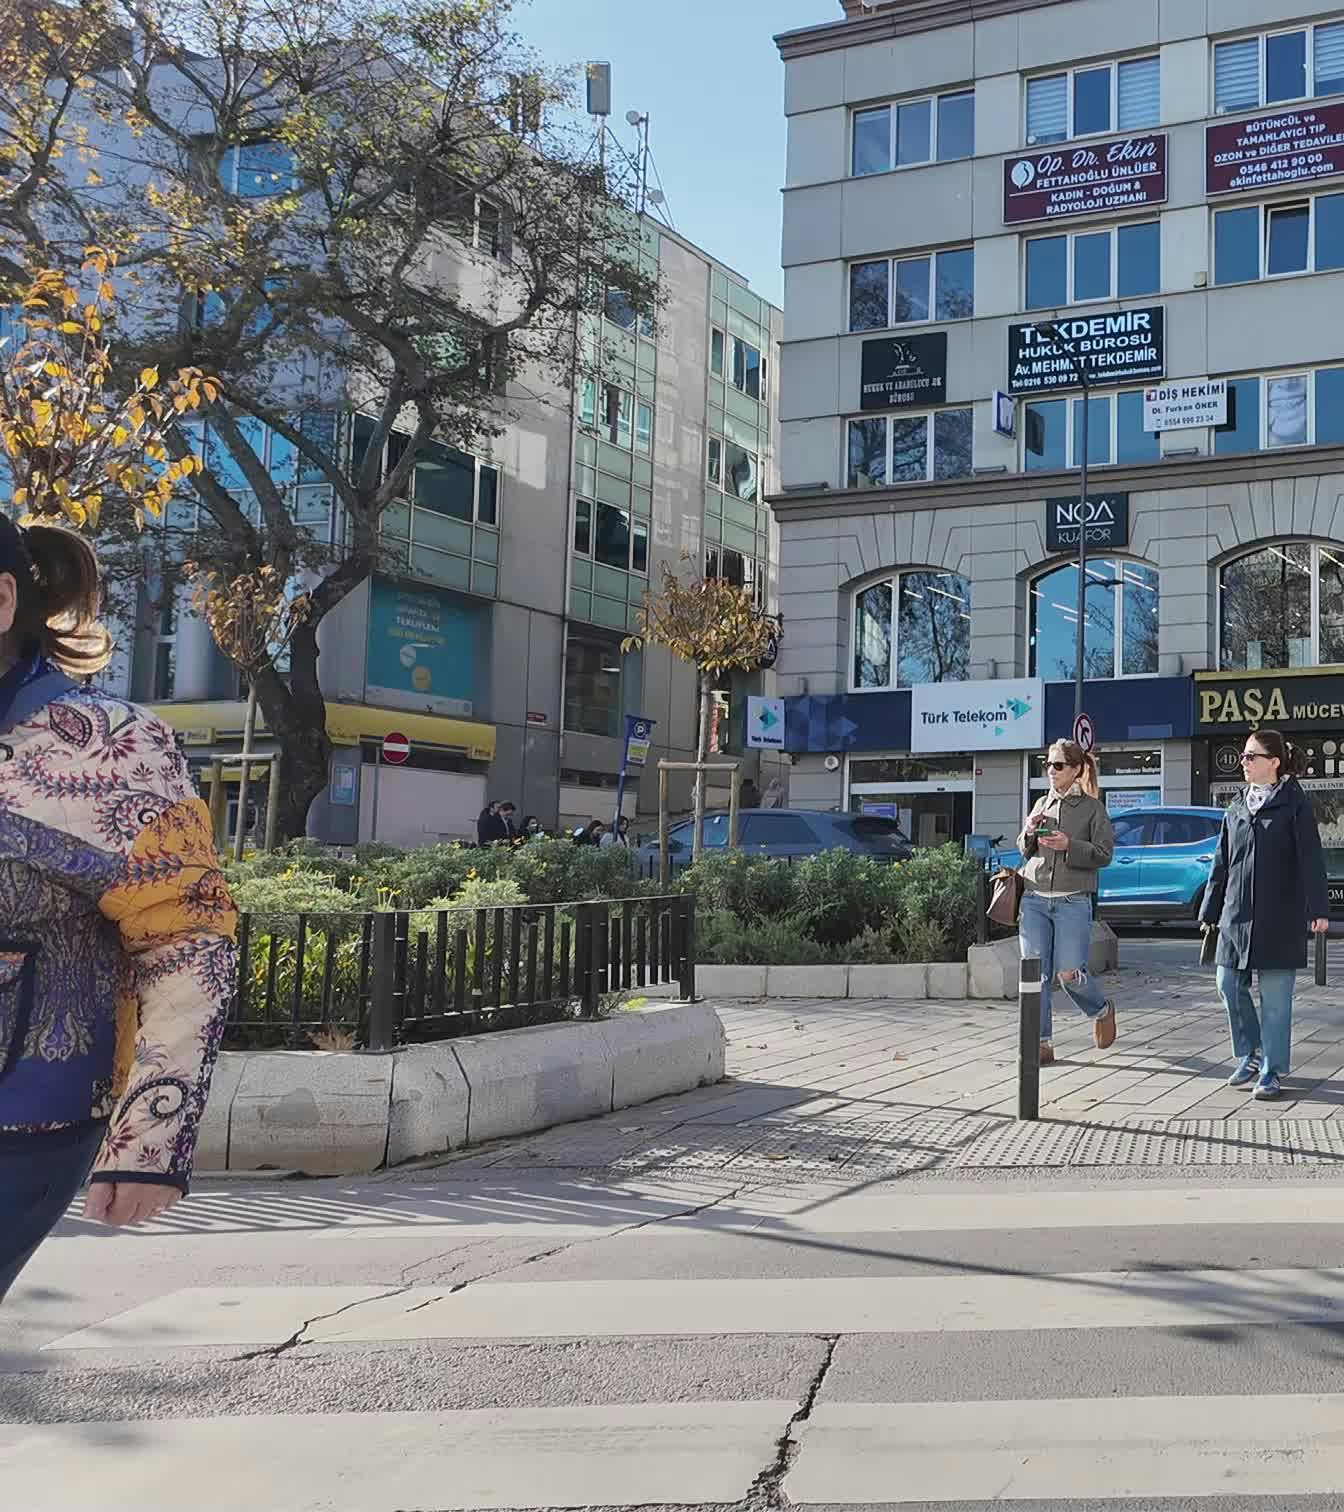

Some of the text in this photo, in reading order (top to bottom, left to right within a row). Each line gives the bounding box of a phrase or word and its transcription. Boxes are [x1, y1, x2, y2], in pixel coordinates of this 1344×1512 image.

[1304, 114, 1315, 122] ve
[1310, 123, 1326, 133] TIP
[1037, 139, 1158, 176] Op. Dr. Ekin
[1214, 151, 1243, 163] OZON
[1246, 149, 1257, 157] ve
[1240, 153, 1323, 175] 0546 412 90 00
[1036, 161, 1158, 189] FETTAHOĞLU ÜNLÜER
[1051, 189, 1084, 203] KADIN
[1092, 181, 1131, 197] DOĞUM
[1133, 180, 1141, 190] &
[1105, 192, 1147, 206] UZMANI
[1080, 332, 1152, 352] BÜROSU
[1014, 363, 1031, 377] Av.
[1089, 345, 1158, 368] TEKDEMİR
[1159, 381, 1224, 401] DİŞ HEKİMİ
[1056, 500, 1115, 524] NOA
[920, 708, 1008, 725] Türk Telekom
[1199, 688, 1290, 731] PAŞA
